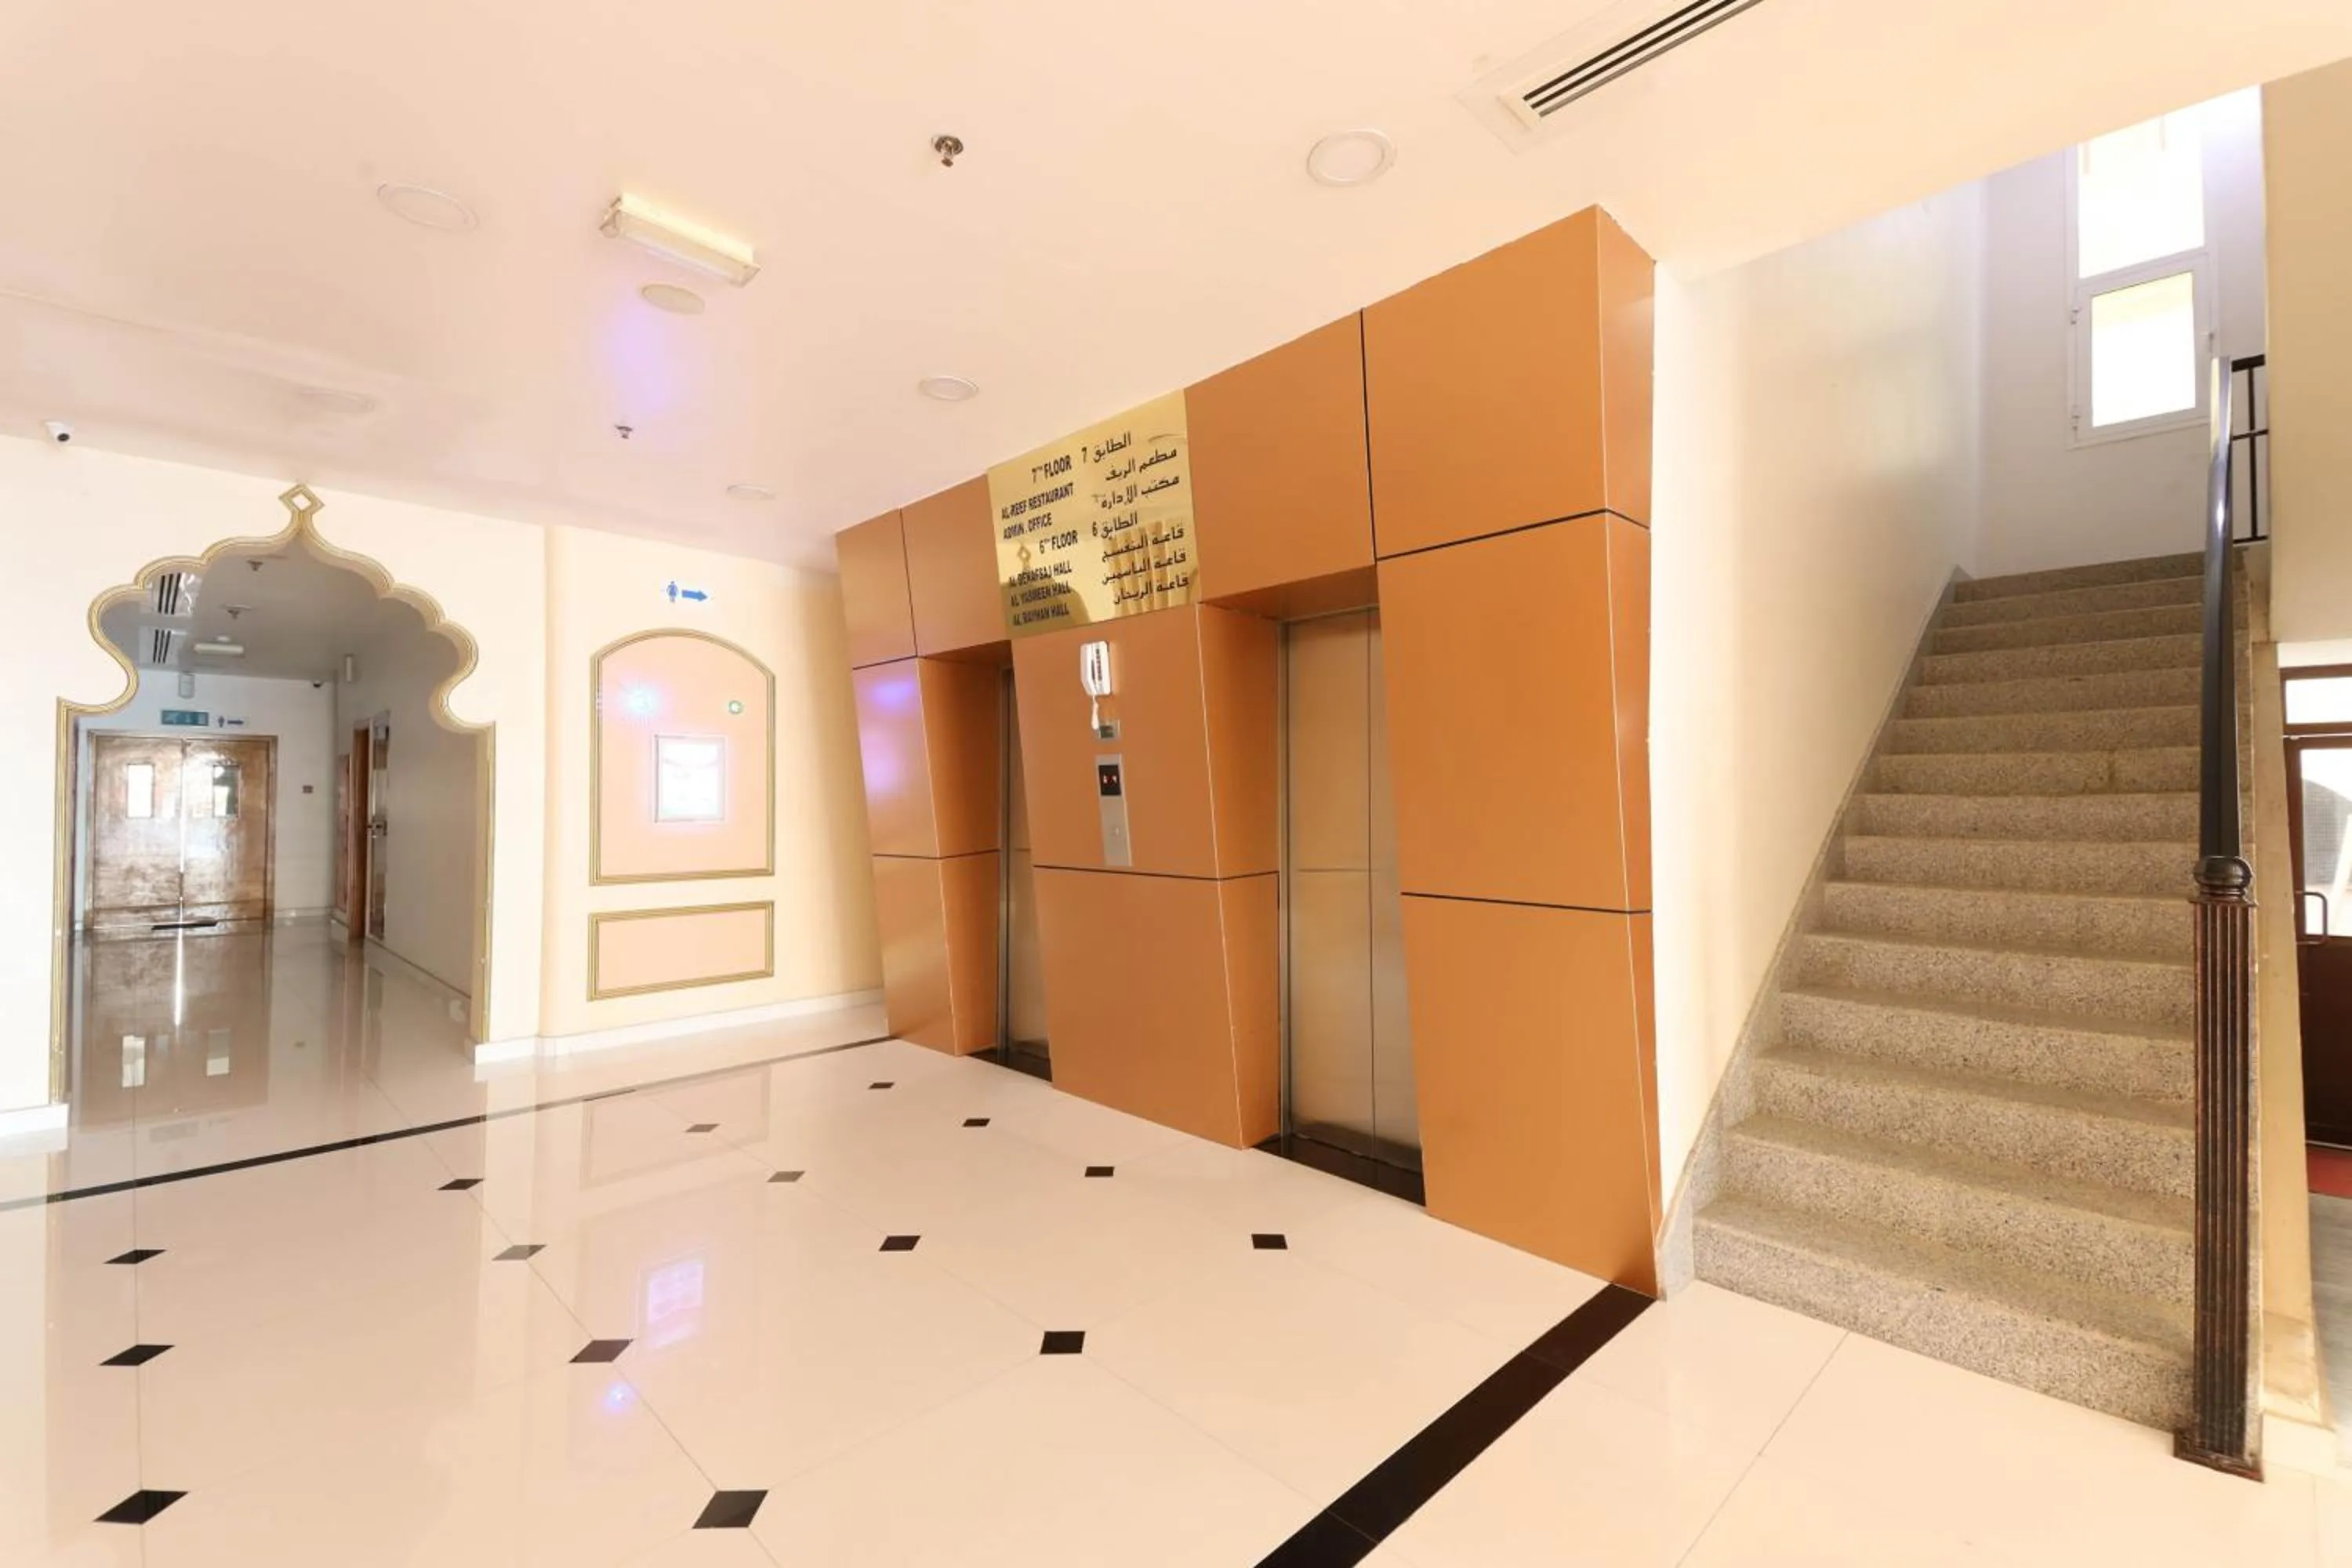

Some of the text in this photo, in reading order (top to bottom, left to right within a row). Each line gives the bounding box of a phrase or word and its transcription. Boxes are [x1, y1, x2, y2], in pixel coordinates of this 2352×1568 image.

[1081, 446, 1087, 464] 7
[1139, 448, 1177, 473] مطعم
[1044, 455, 1072, 479] FLOOR
[1029, 481, 1073, 510] RESTAURANT
[1141, 476, 1179, 499] مكتب
[1028, 512, 1052, 532] OFFICE
[1092, 521, 1098, 537] 6
[1051, 530, 1078, 550] FLOOR
[1054, 560, 1072, 576] HALL
[1051, 580, 1071, 596] HALL
[1051, 602, 1069, 618] HALL
